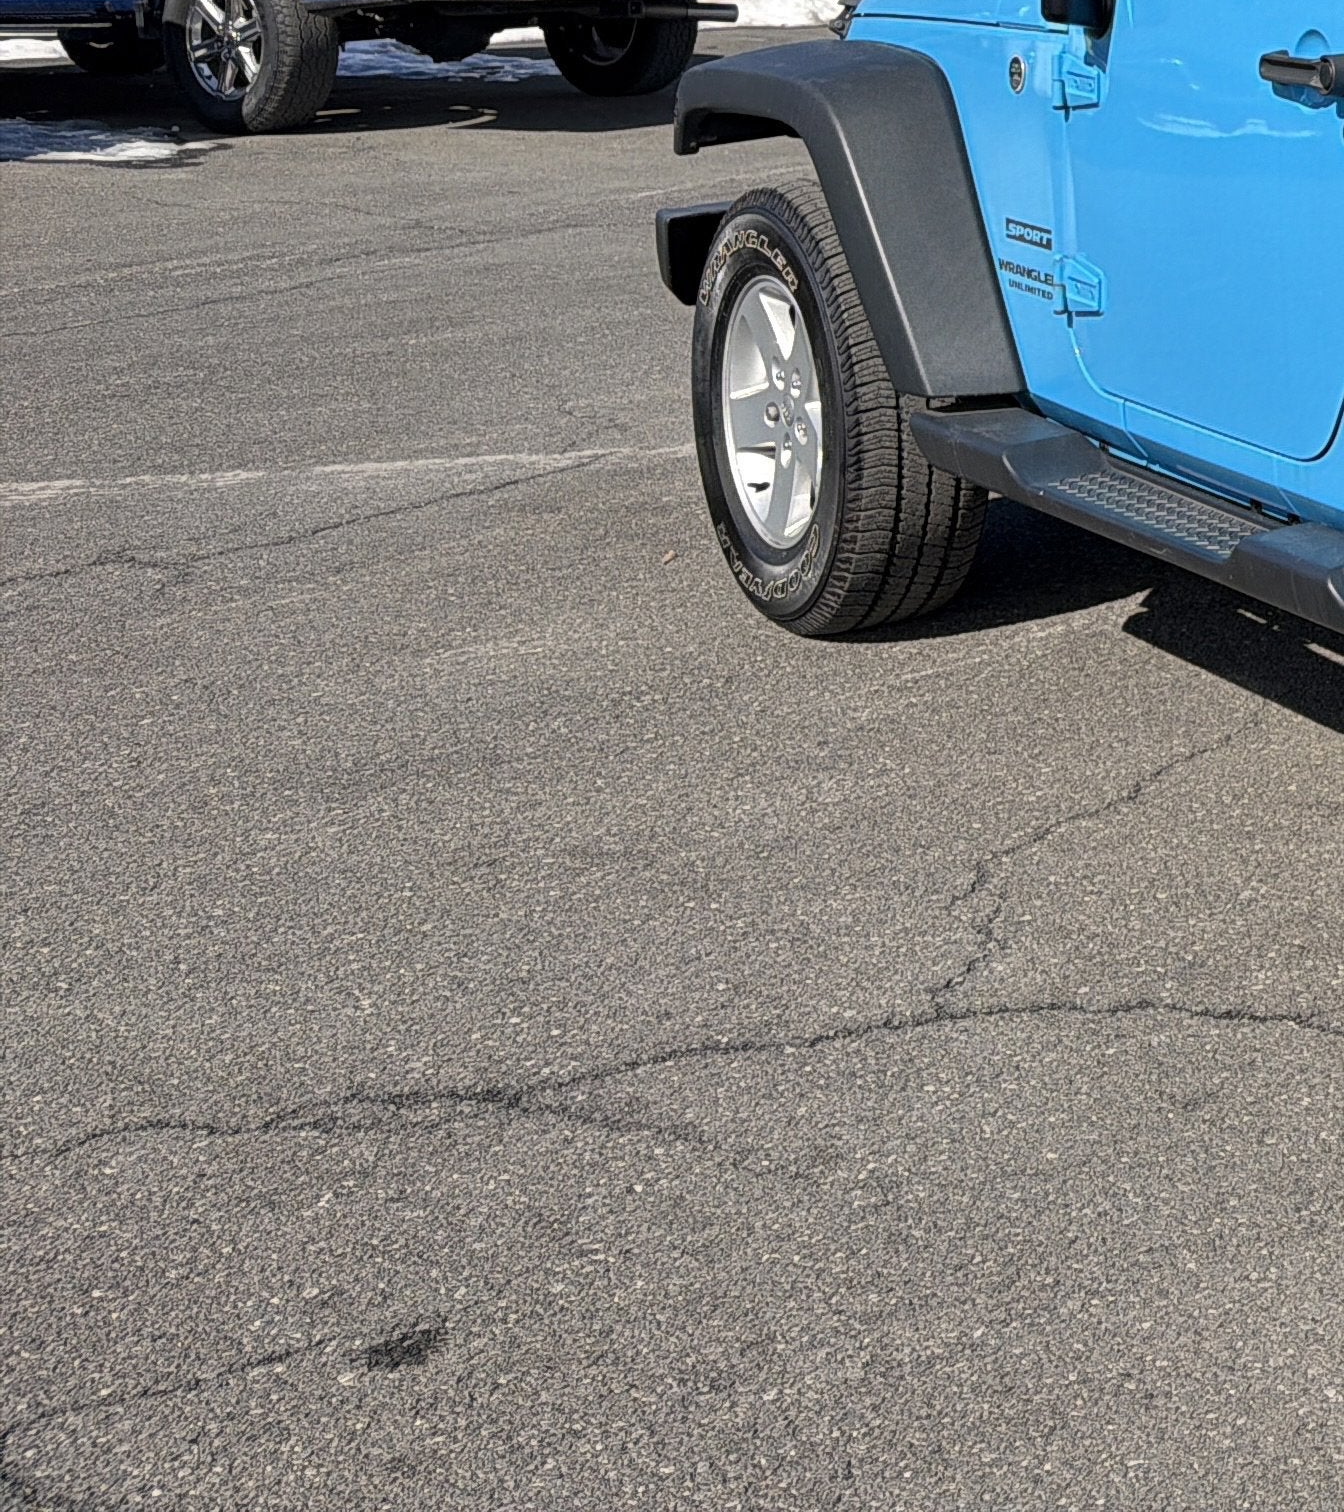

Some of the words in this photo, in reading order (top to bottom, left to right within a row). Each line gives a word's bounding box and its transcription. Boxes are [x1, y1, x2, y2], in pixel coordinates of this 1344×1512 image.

[1008, 223, 1052, 245] SPORT
[699, 229, 799, 307] WRANGLER
[998, 258, 1054, 285] WRANGLE
[1008, 278, 1054, 301] UNLIMITED
[717, 521, 820, 602] GOODYEAR
